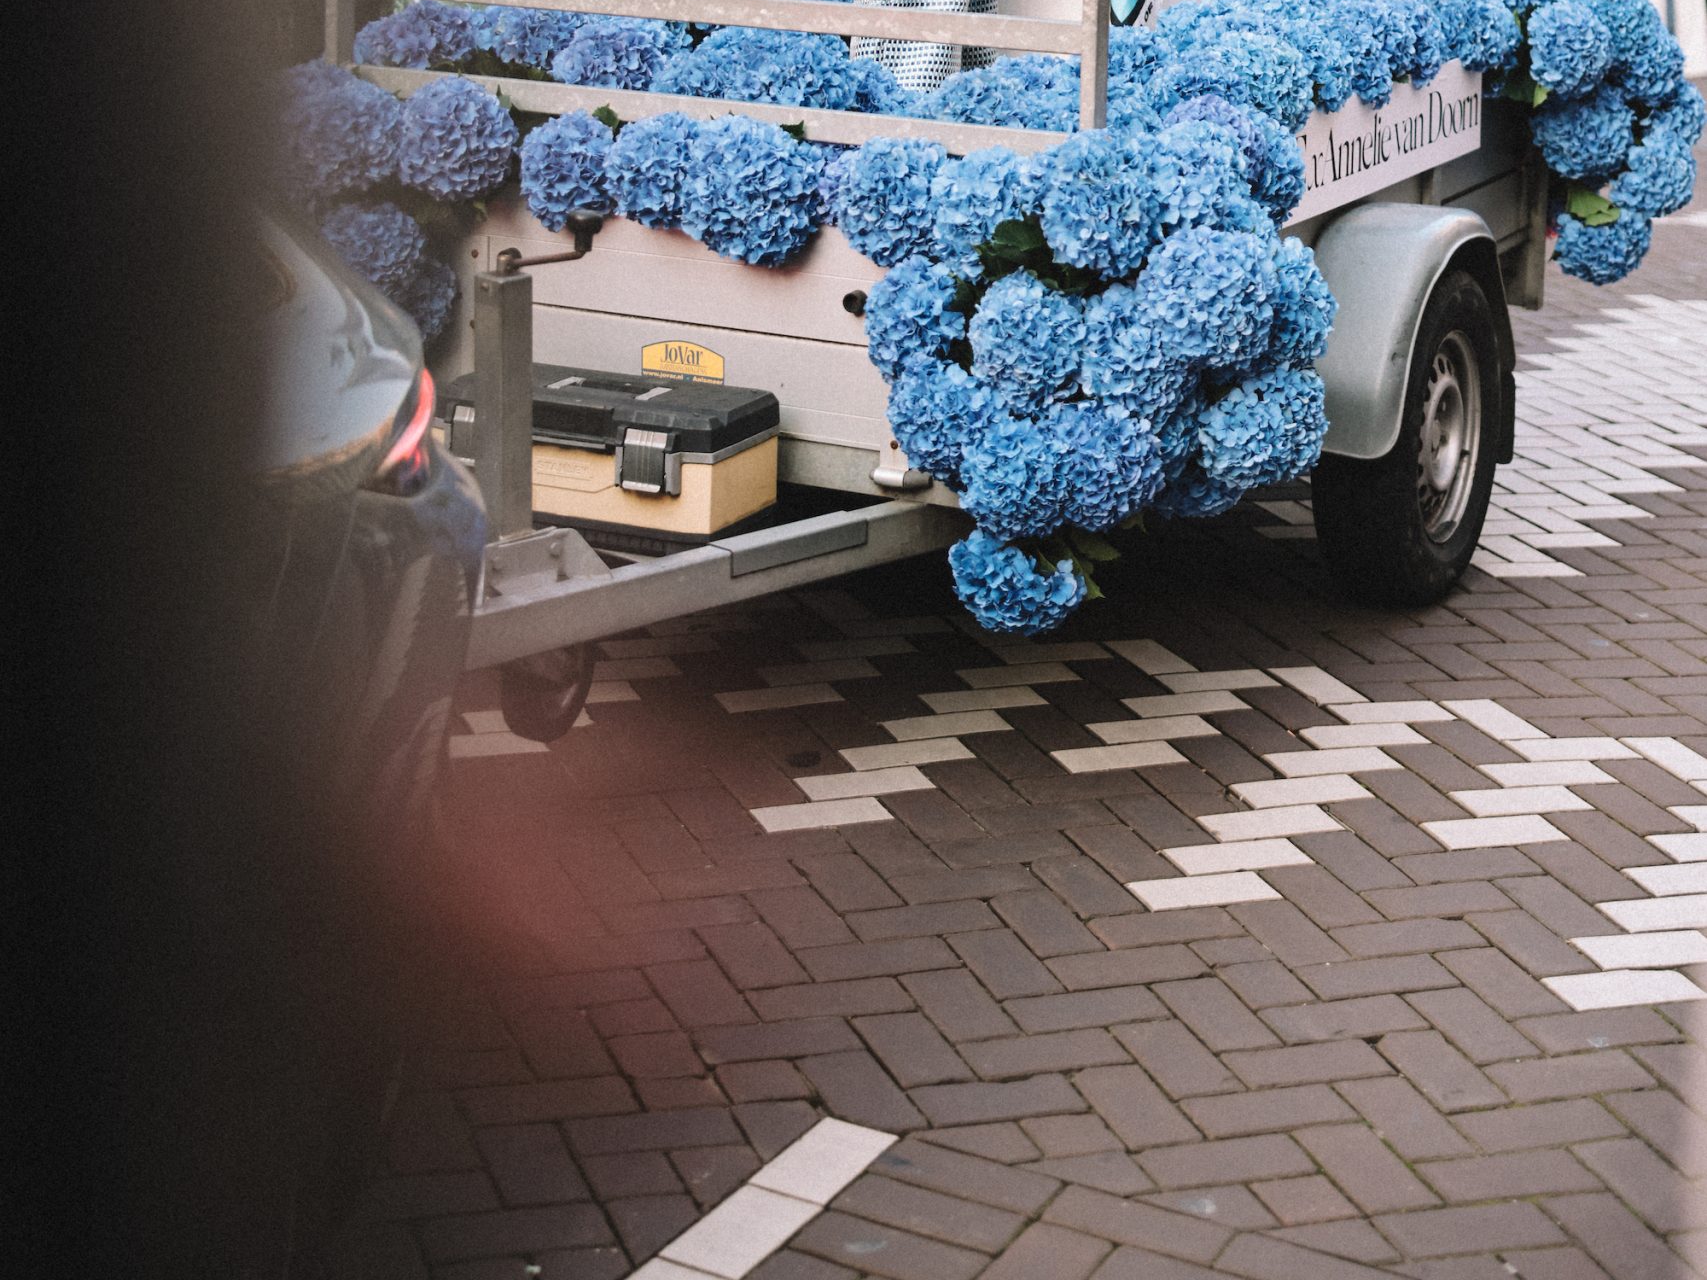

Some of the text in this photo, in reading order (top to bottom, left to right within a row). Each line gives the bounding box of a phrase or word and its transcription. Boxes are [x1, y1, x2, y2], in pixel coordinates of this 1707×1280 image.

[1321, 113, 1392, 187] Annelie
[1394, 112, 1424, 157] van
[1427, 90, 1479, 144] Doorn
[660, 344, 704, 366] JoVar
